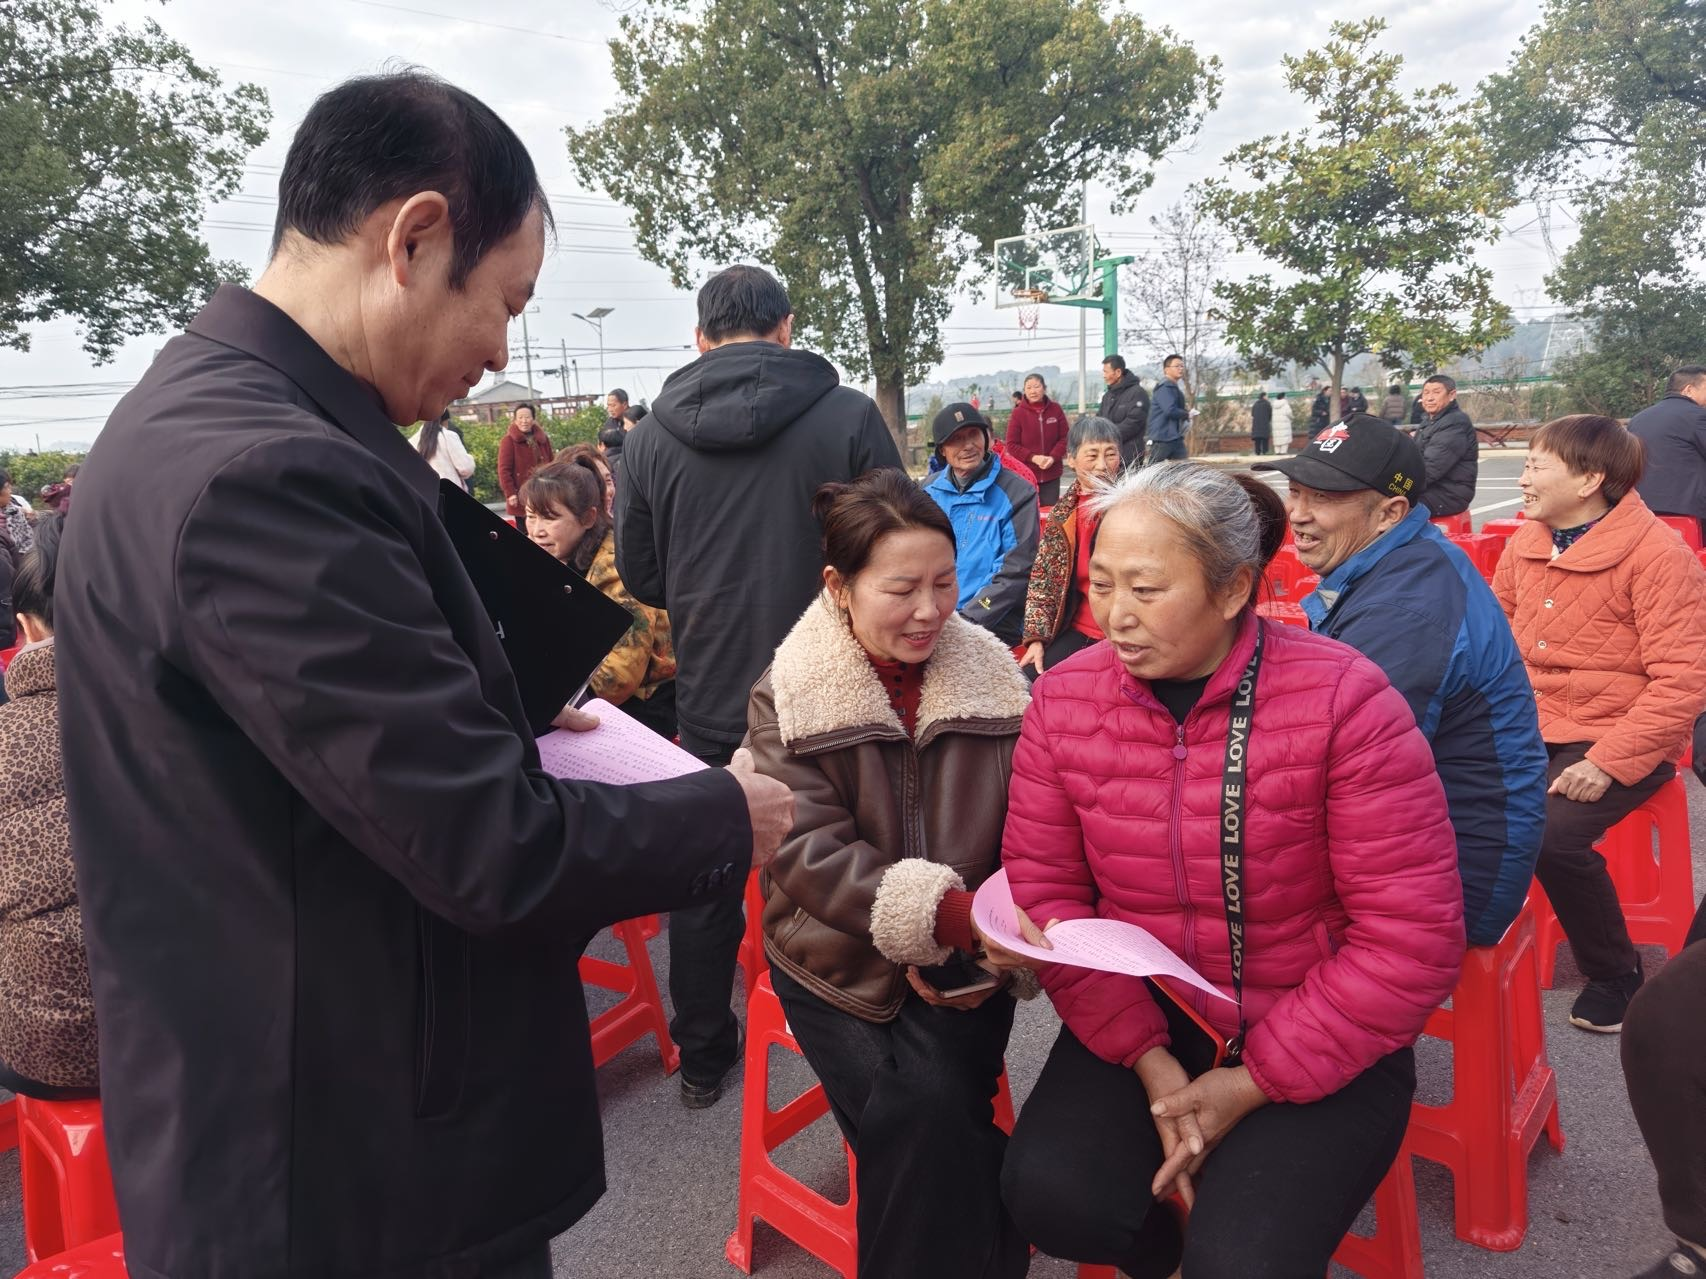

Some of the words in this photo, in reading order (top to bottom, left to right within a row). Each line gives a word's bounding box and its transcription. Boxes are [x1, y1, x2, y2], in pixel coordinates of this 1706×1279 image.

[1388, 482, 1406, 496] CHINA
[1393, 472, 1414, 491] 中国
[1228, 716, 1248, 773] LOVE
[1224, 784, 1241, 844] LOVE
[1225, 854, 1241, 914] LOVE
[1231, 921, 1243, 981] LOVE
